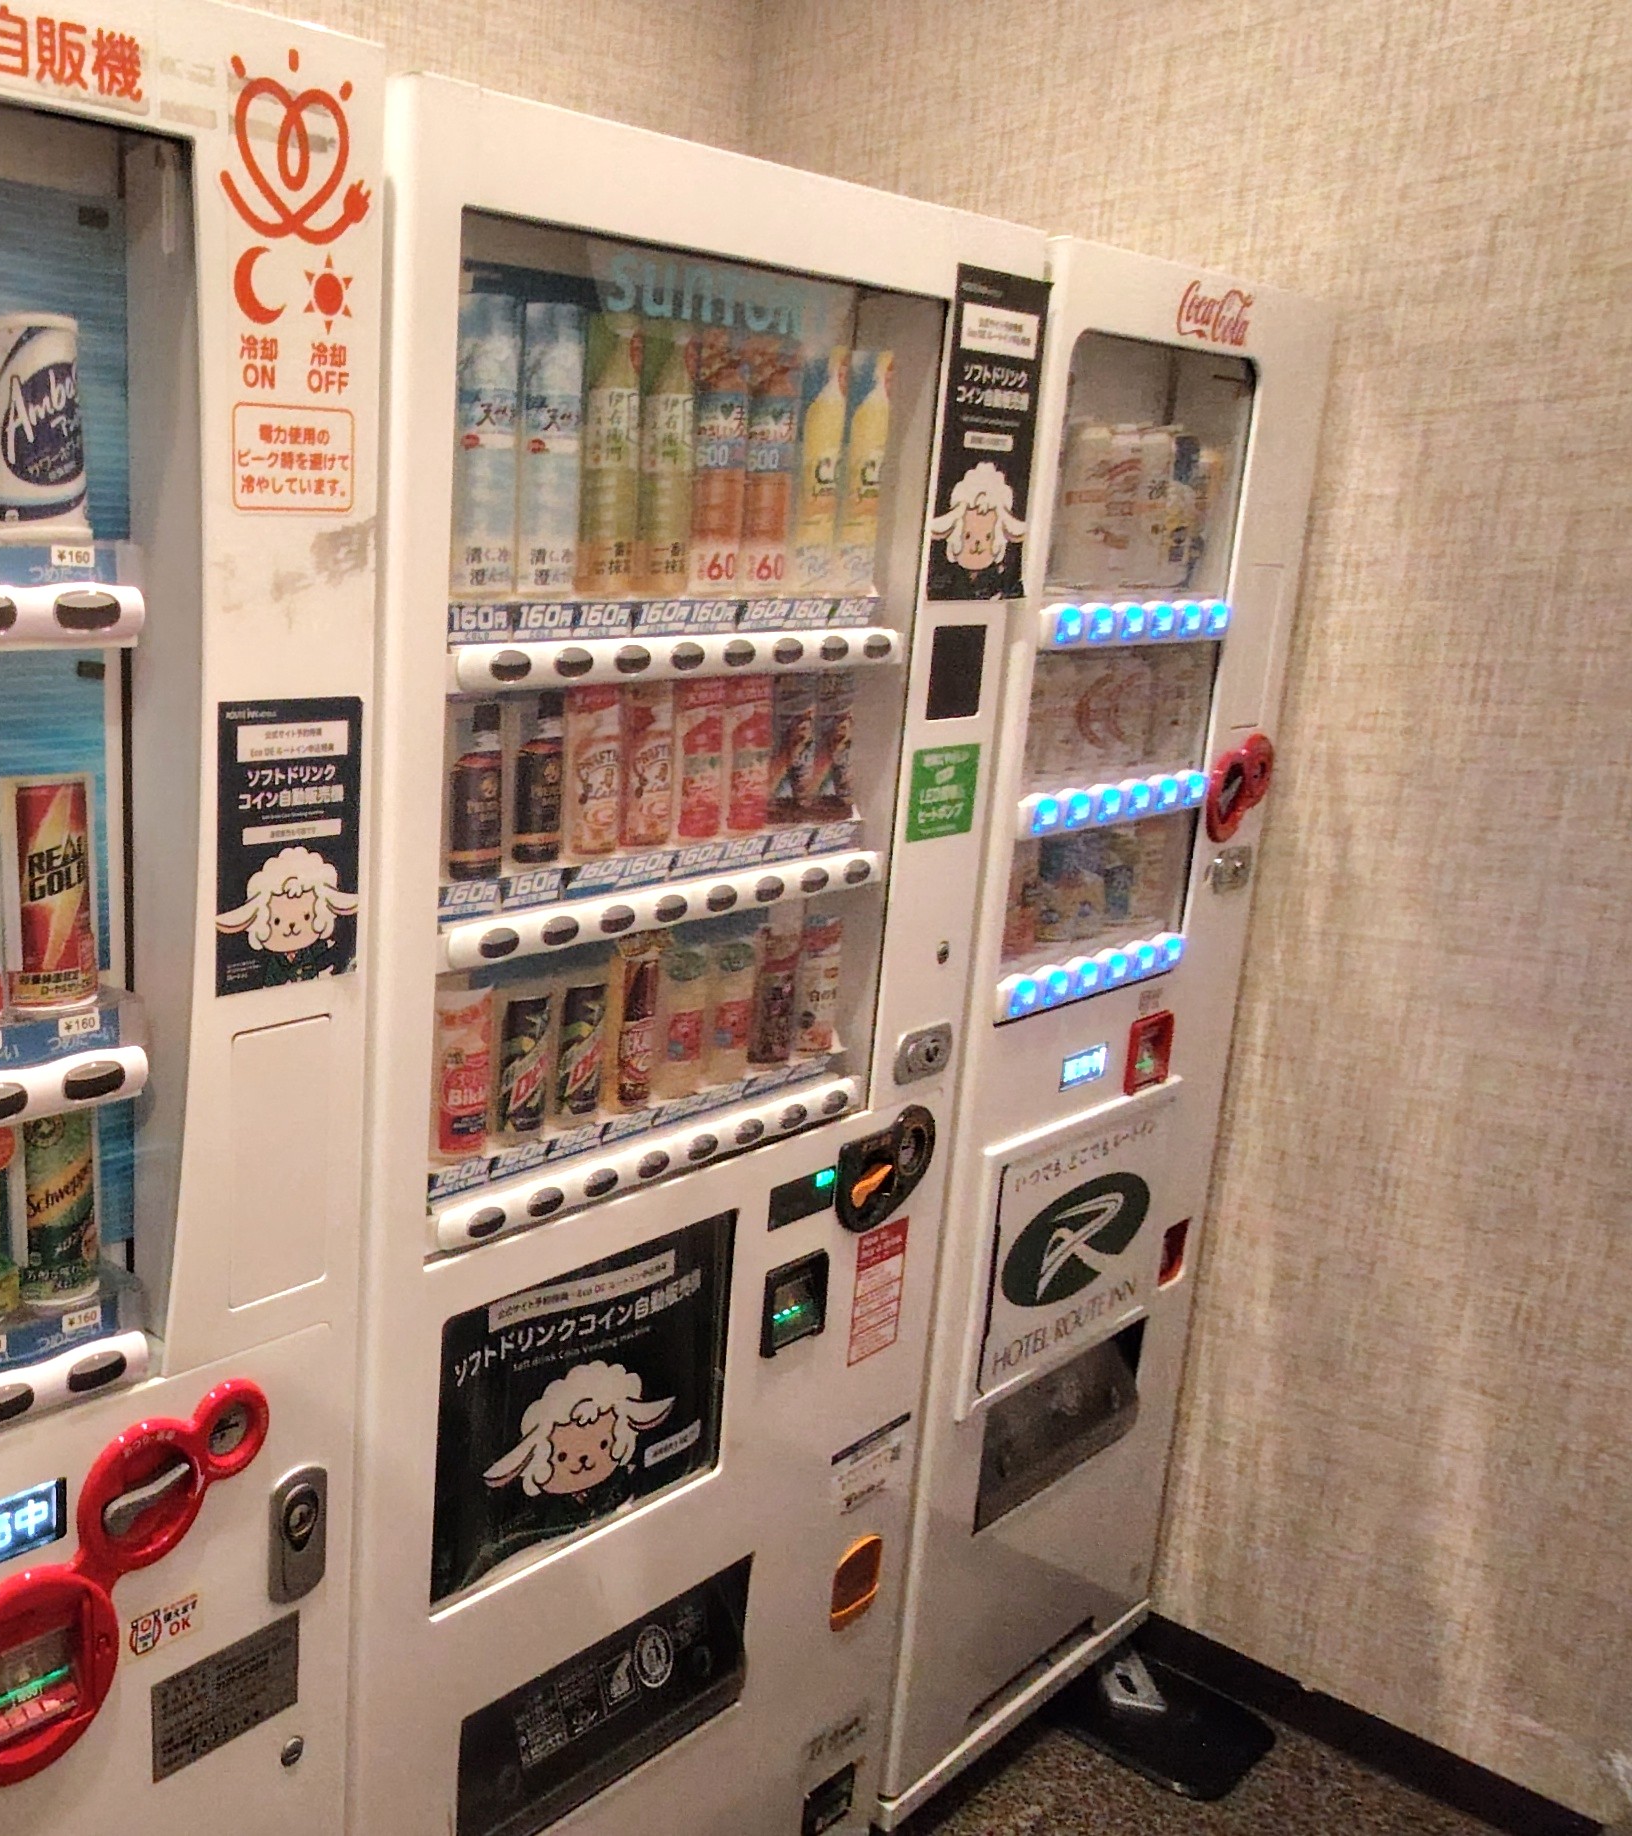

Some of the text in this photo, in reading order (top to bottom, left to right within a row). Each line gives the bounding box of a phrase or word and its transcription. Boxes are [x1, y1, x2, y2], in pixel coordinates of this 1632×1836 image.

[1176, 280, 1253, 347] Coca-Cola
[239, 333, 278, 362] 冷却
[310, 342, 347, 367] 冷却
[243, 363, 275, 390] ON
[307, 369, 349, 395] OFF
[964, 364, 1028, 388] ソフトドリンク
[259, 424, 330, 445] 電力使用の
[241, 474, 346, 497] 冷やしています。
[57, 549, 90, 564] ¥160
[247, 764, 336, 787] ソフトドリンク
[238, 784, 344, 810] コイン自動販売機
[64, 1016, 96, 1031] ¥160
[68, 1312, 97, 1327] ¥160
[992, 1324, 1049, 1375] HOTEL
[1053, 1294, 1105, 1342] ROUTE
[169, 1618, 191, 1636] OK
